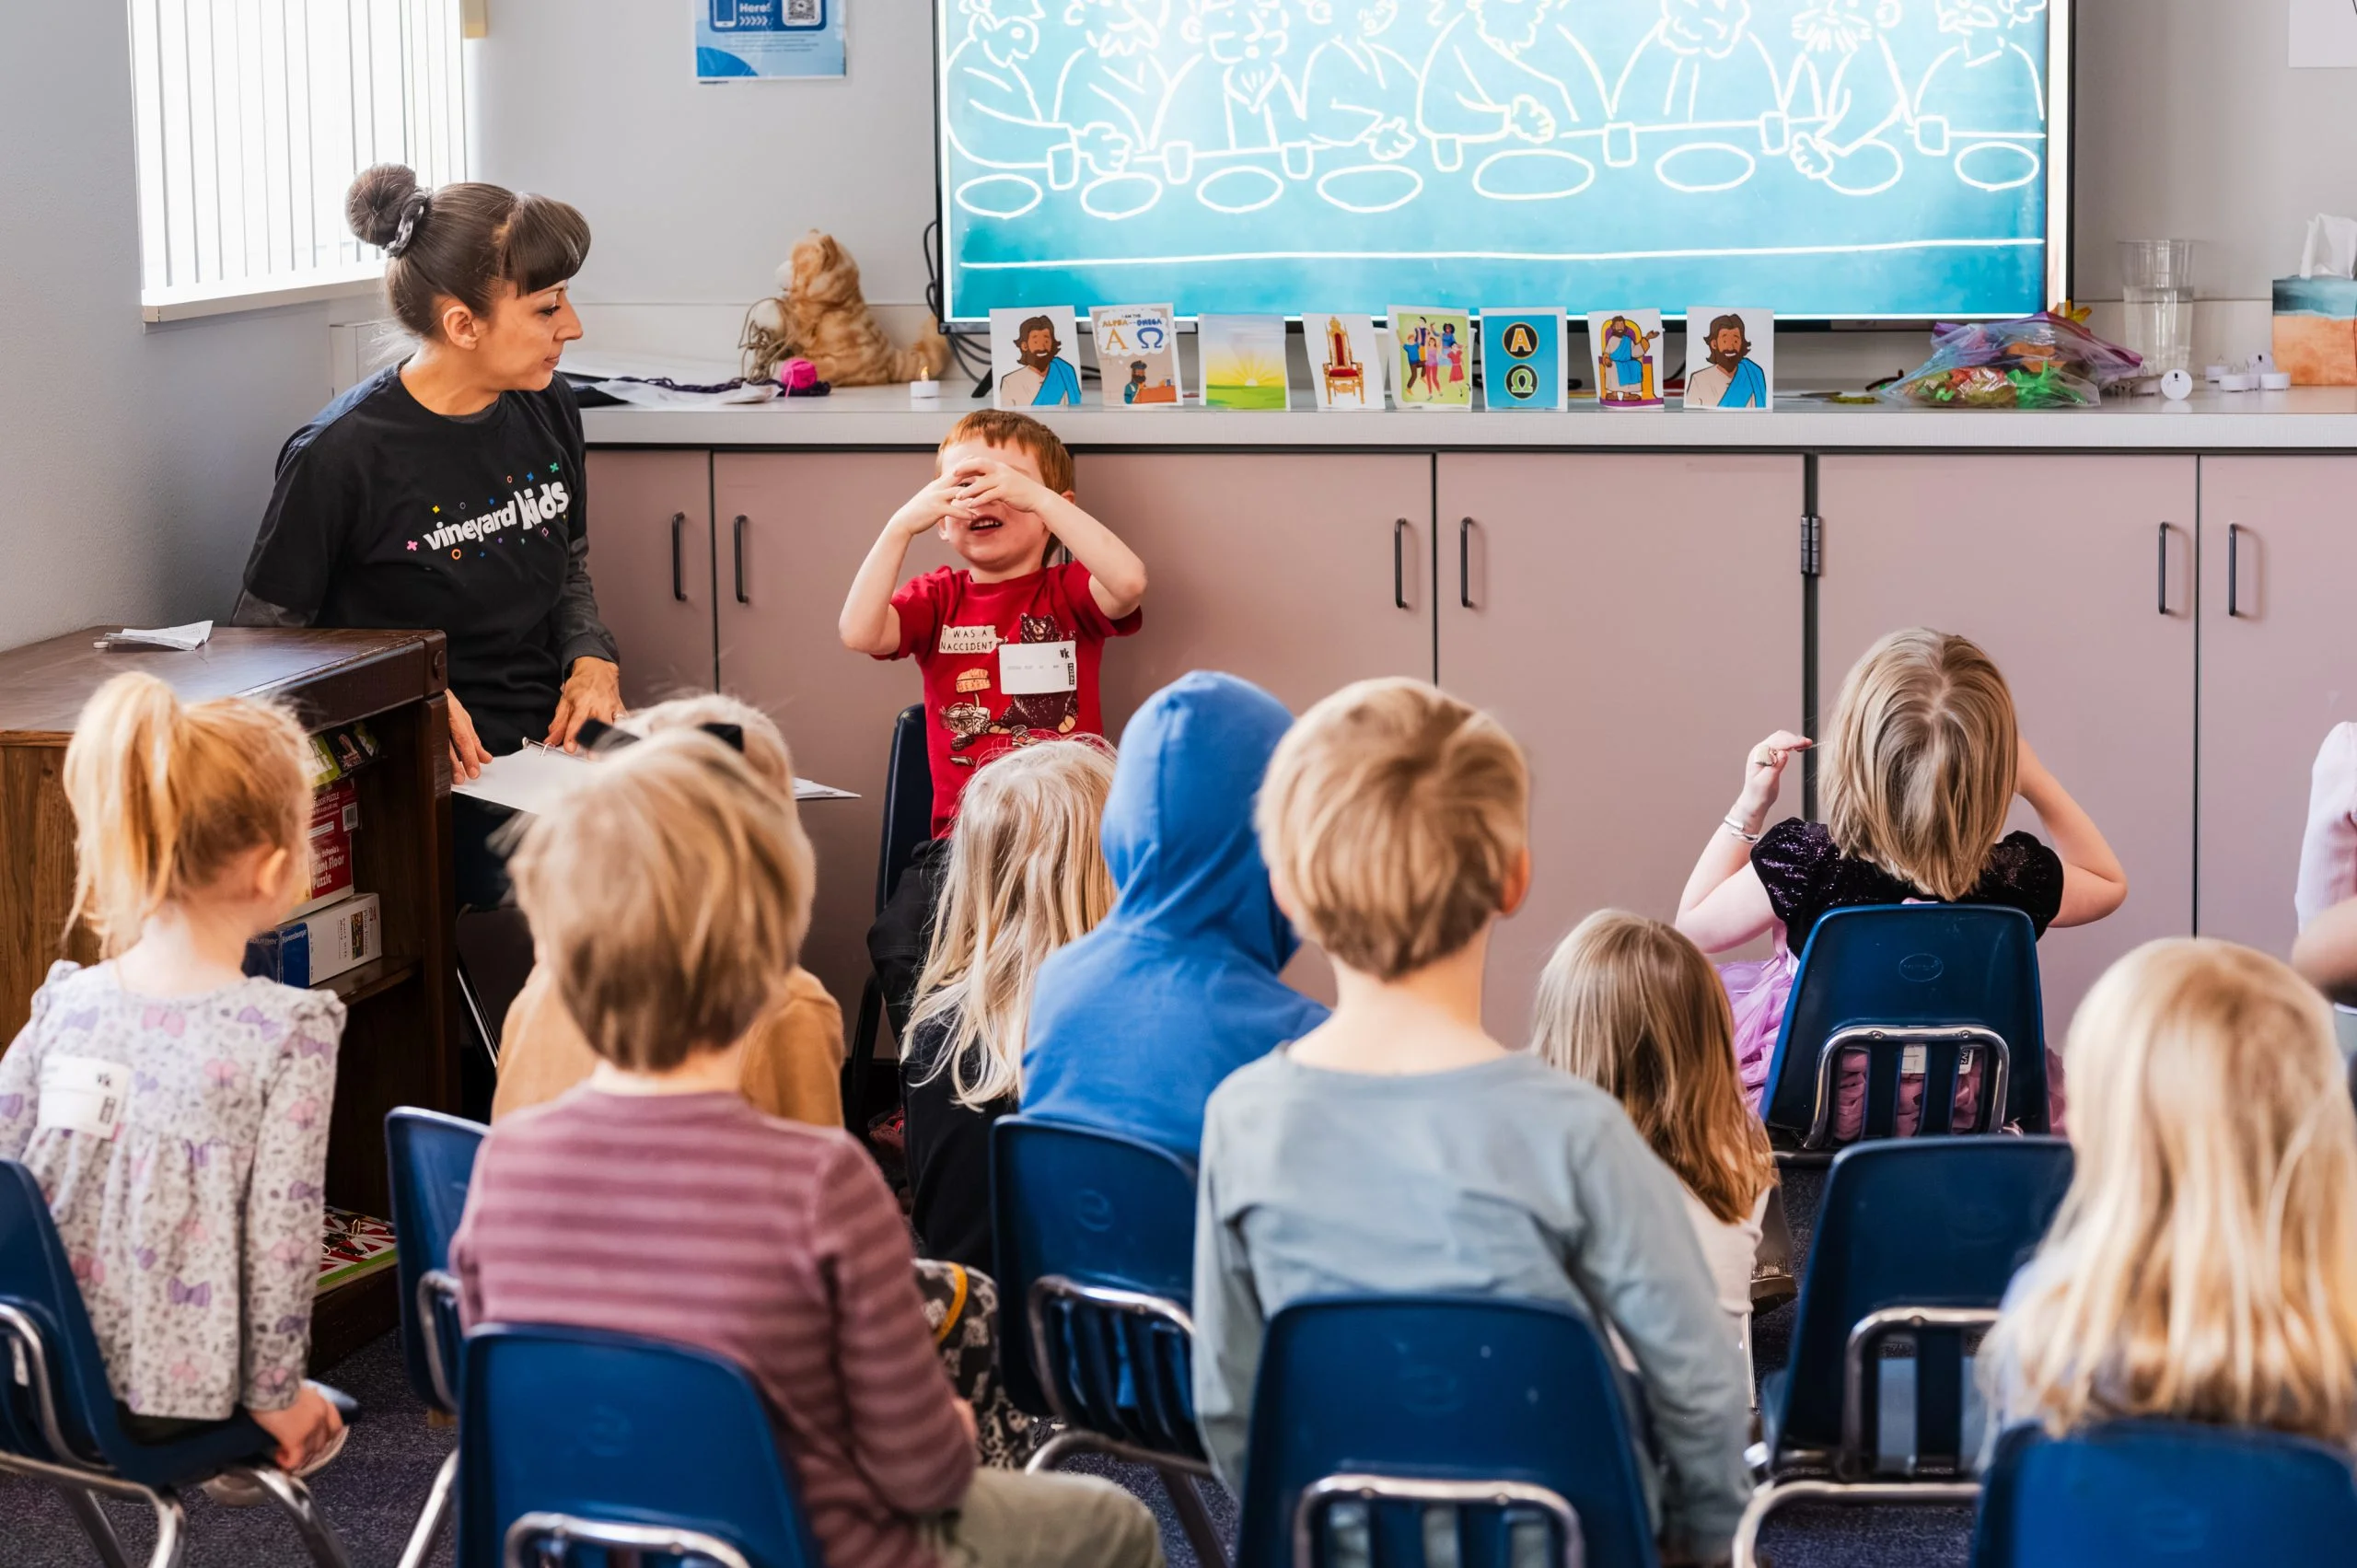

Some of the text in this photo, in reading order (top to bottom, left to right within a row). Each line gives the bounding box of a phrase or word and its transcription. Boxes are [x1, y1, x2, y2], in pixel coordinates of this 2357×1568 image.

[423, 482, 569, 551] vineyard kids
[953, 629, 976, 638] WAS
[981, 629, 988, 638] A
[940, 641, 993, 651] NACCIDENT
